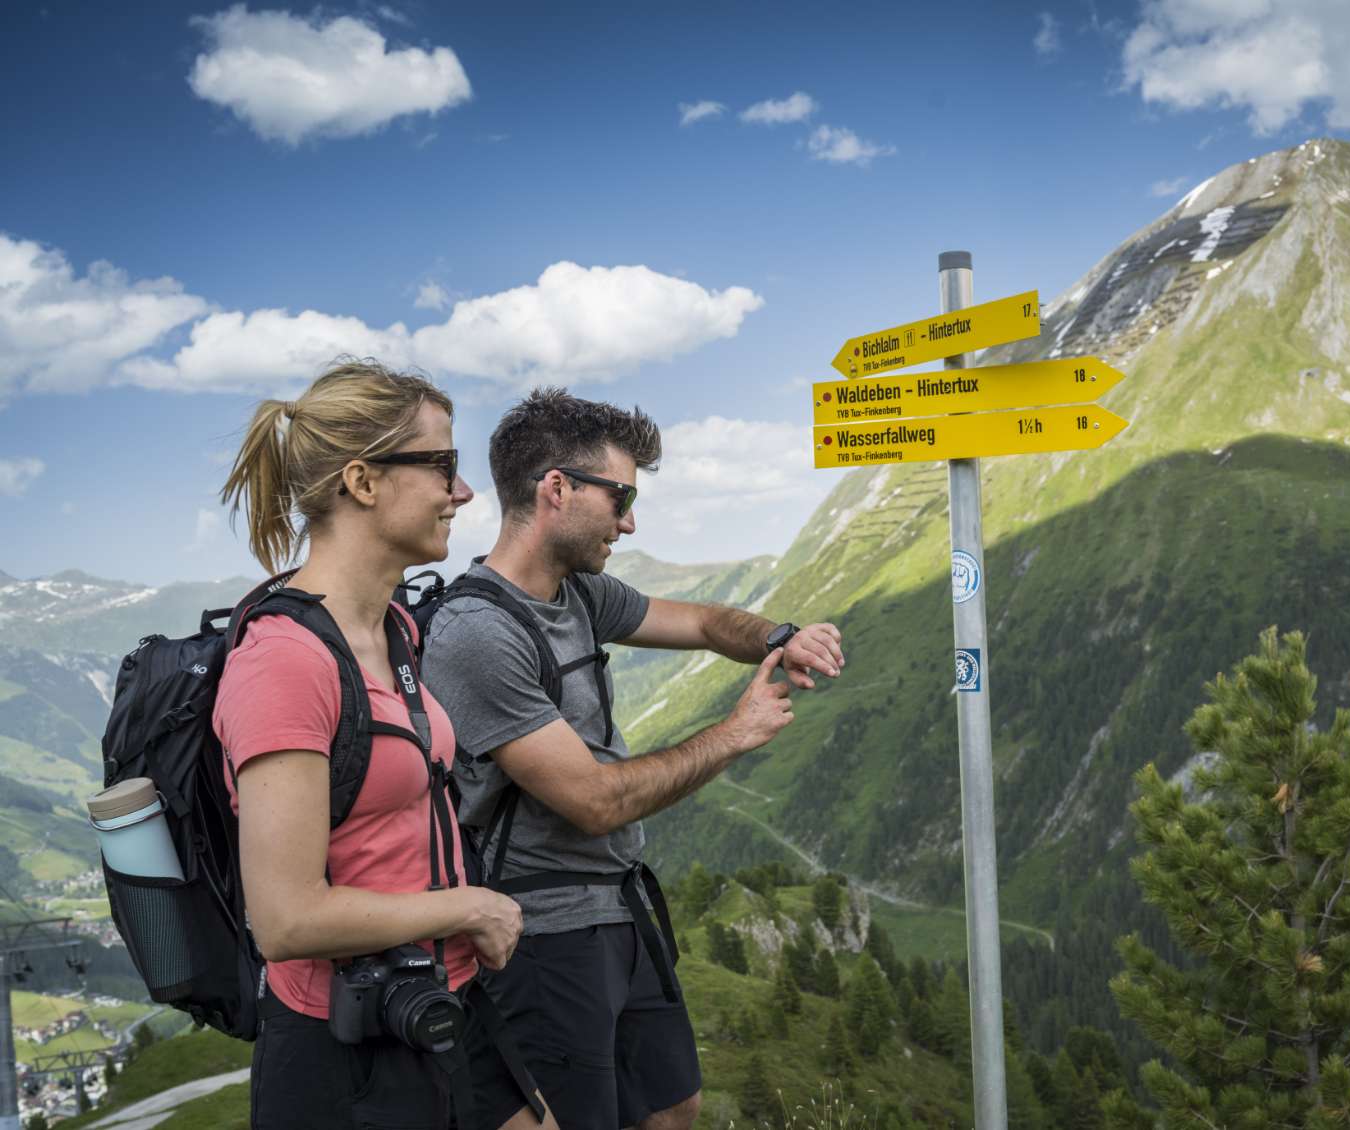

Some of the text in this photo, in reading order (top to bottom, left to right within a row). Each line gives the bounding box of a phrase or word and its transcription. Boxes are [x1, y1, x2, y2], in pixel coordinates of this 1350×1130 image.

[1022, 303, 1031, 318] 17
[862, 335, 900, 358] Bichlalm
[928, 318, 971, 341] Hintertux
[836, 383, 901, 404] Waldeben
[917, 377, 979, 397] Hintertux
[837, 405, 902, 418] TVB Tux-Finkenberg
[837, 426, 935, 448] Wasserfallweg
[837, 450, 903, 462] TVB Tux-Finkenberg
[398, 664, 416, 694] EOS
